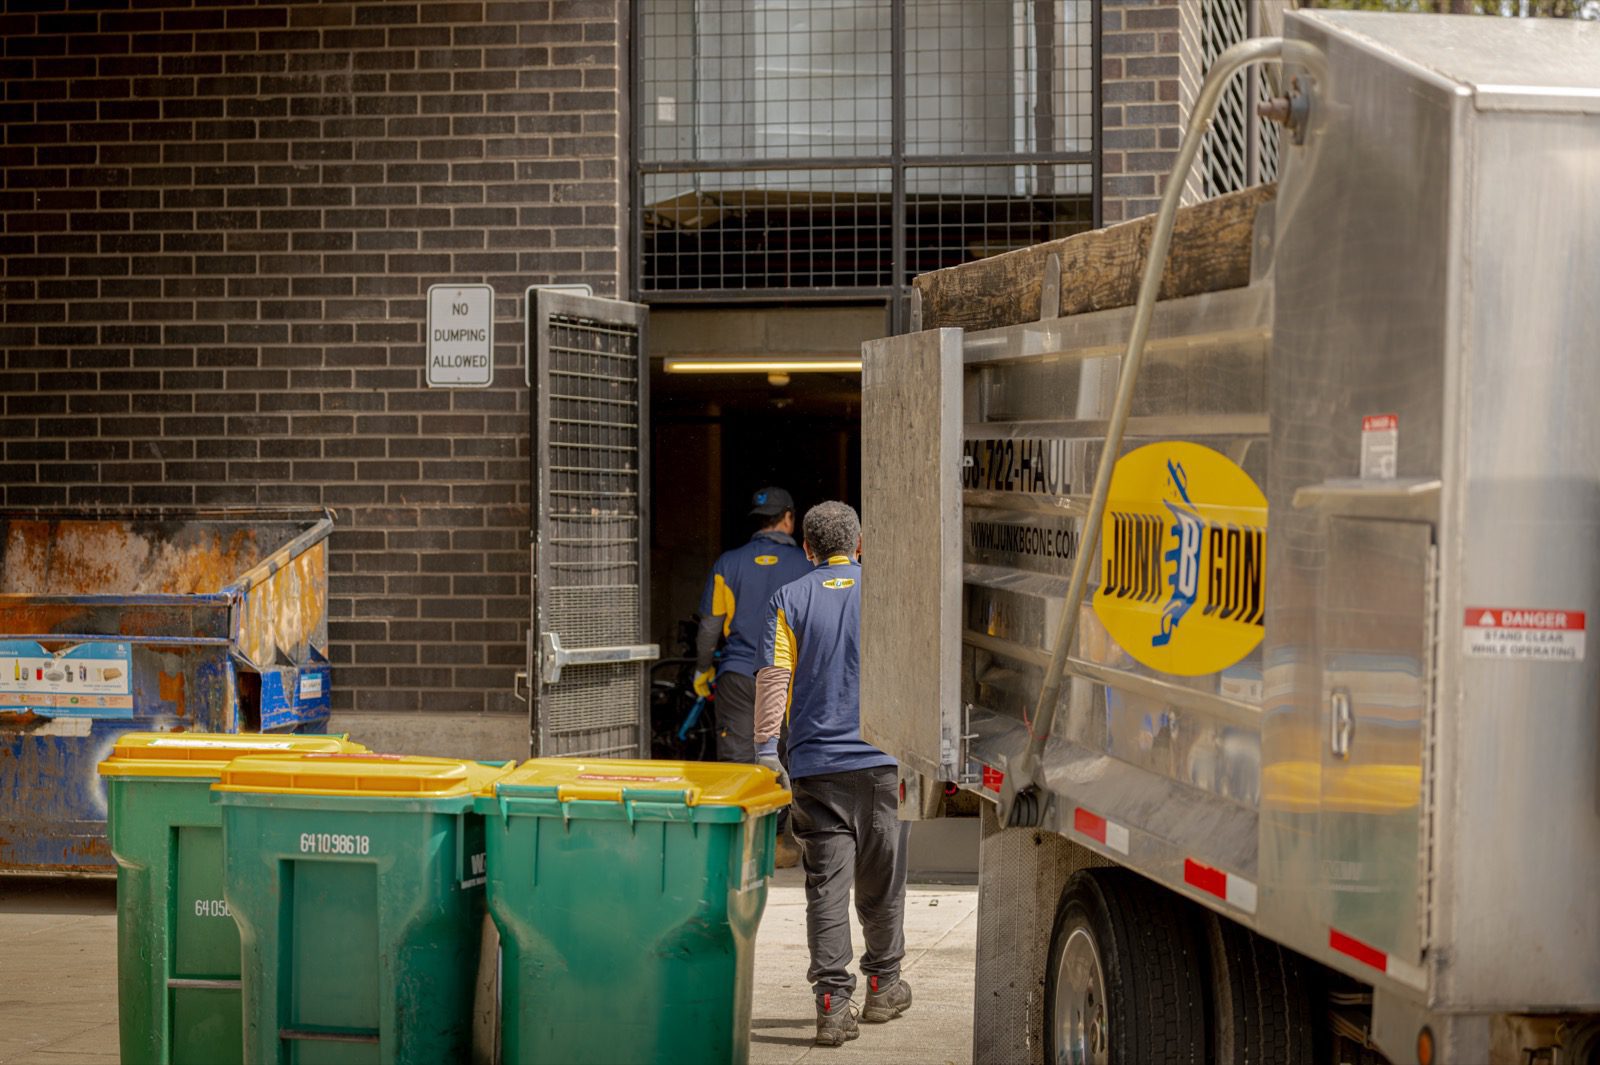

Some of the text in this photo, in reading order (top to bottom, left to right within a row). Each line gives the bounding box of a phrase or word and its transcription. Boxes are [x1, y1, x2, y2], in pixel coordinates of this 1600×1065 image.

[452, 302, 469, 316] NO
[434, 328, 486, 343] DUMPING
[433, 354, 488, 369] ALLOWED
[1103, 511, 1164, 604] JUNK
[1202, 519, 1264, 628] GON
[1501, 609, 1568, 629] DANGER
[1484, 630, 1564, 643] STAND CLEAR
[1471, 644, 1577, 658] WHILE OPERATING
[300, 832, 370, 855] 641098618
